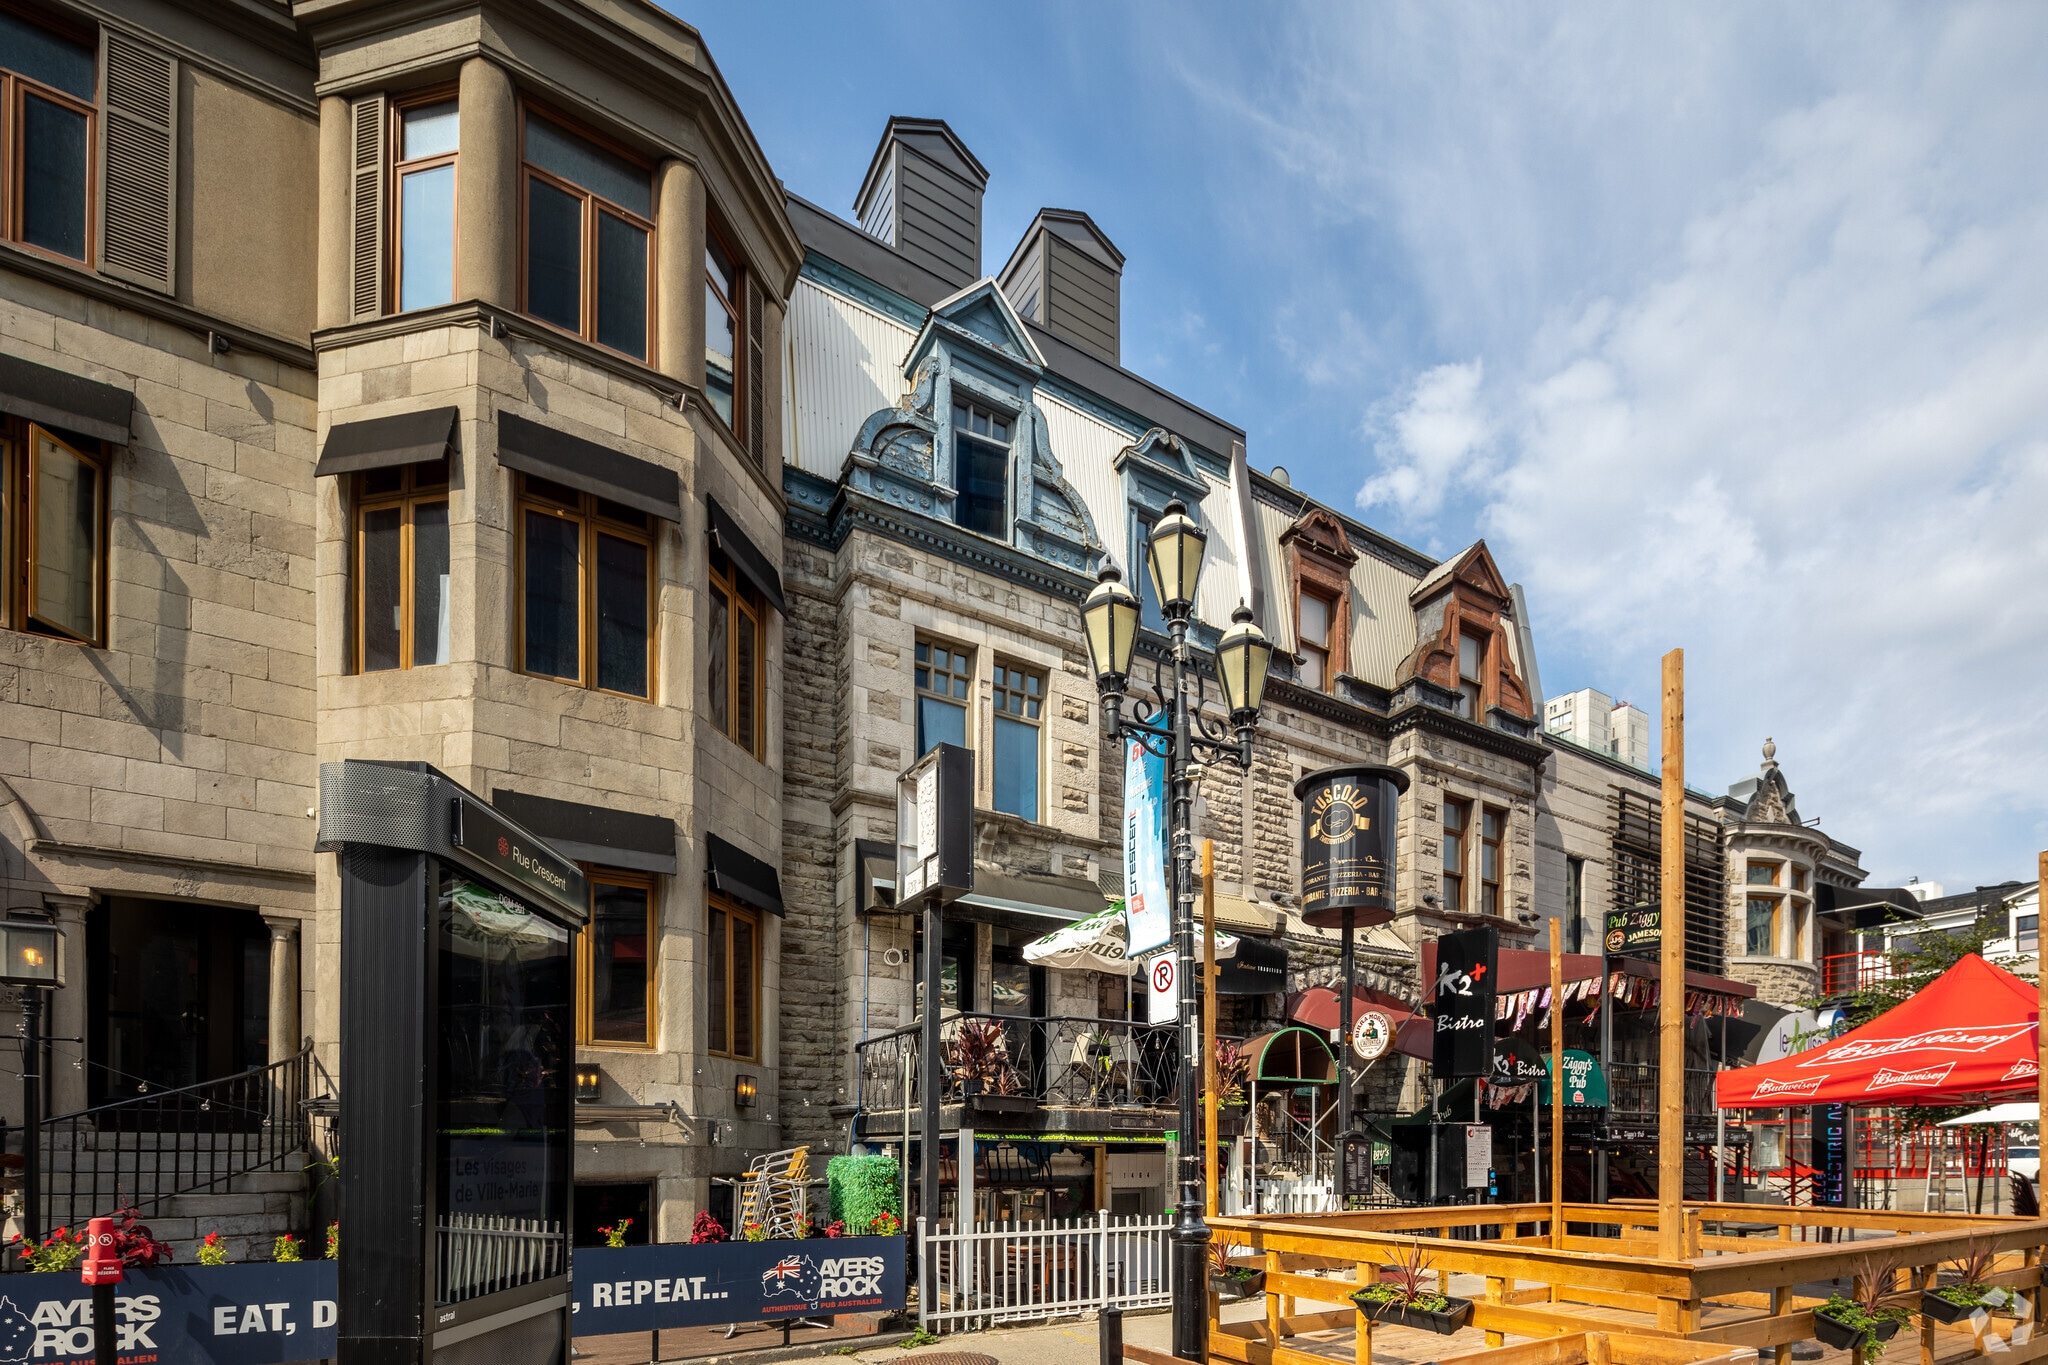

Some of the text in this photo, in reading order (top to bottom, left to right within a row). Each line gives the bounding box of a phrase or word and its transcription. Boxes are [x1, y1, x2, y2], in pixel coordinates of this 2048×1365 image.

[1311, 784, 1368, 815] TUSCOLO
[512, 845, 567, 891] Rue Crescent
[1332, 871, 1363, 879] PIZZERIA
[1368, 871, 1380, 879] BAR
[1330, 886, 1360, 897] PIZZERIA
[1366, 886, 1379, 897] BAR
[1608, 911, 1660, 929] Pub Ziggy
[1355, 1014, 1387, 1038] BIRRA MORETTI
[1437, 1014, 1484, 1032] Bistro
[1827, 1031, 2010, 1061] Budweiser
[1517, 1060, 1546, 1076] Bistro
[1562, 1056, 1593, 1076] Ziggy's
[1569, 1073, 1586, 1089] Pub
[1758, 1080, 1819, 1094] Budweiser
[1876, 1069, 1949, 1085] Budweiser
[456, 1158, 527, 1178] Les visages
[1827, 1126, 1842, 1202] ELECTRIC
[455, 1180, 539, 1203] de Ville-Marie
[820, 1256, 885, 1278] AYERS
[593, 1276, 728, 1308] REPEAT...
[820, 1275, 883, 1299] ROCK
[761, 1298, 882, 1313] AUTHENTIQUE PUB AUSTRALIEN
[213, 1302, 296, 1336] EAT,
[439, 1310, 456, 1324] astral
